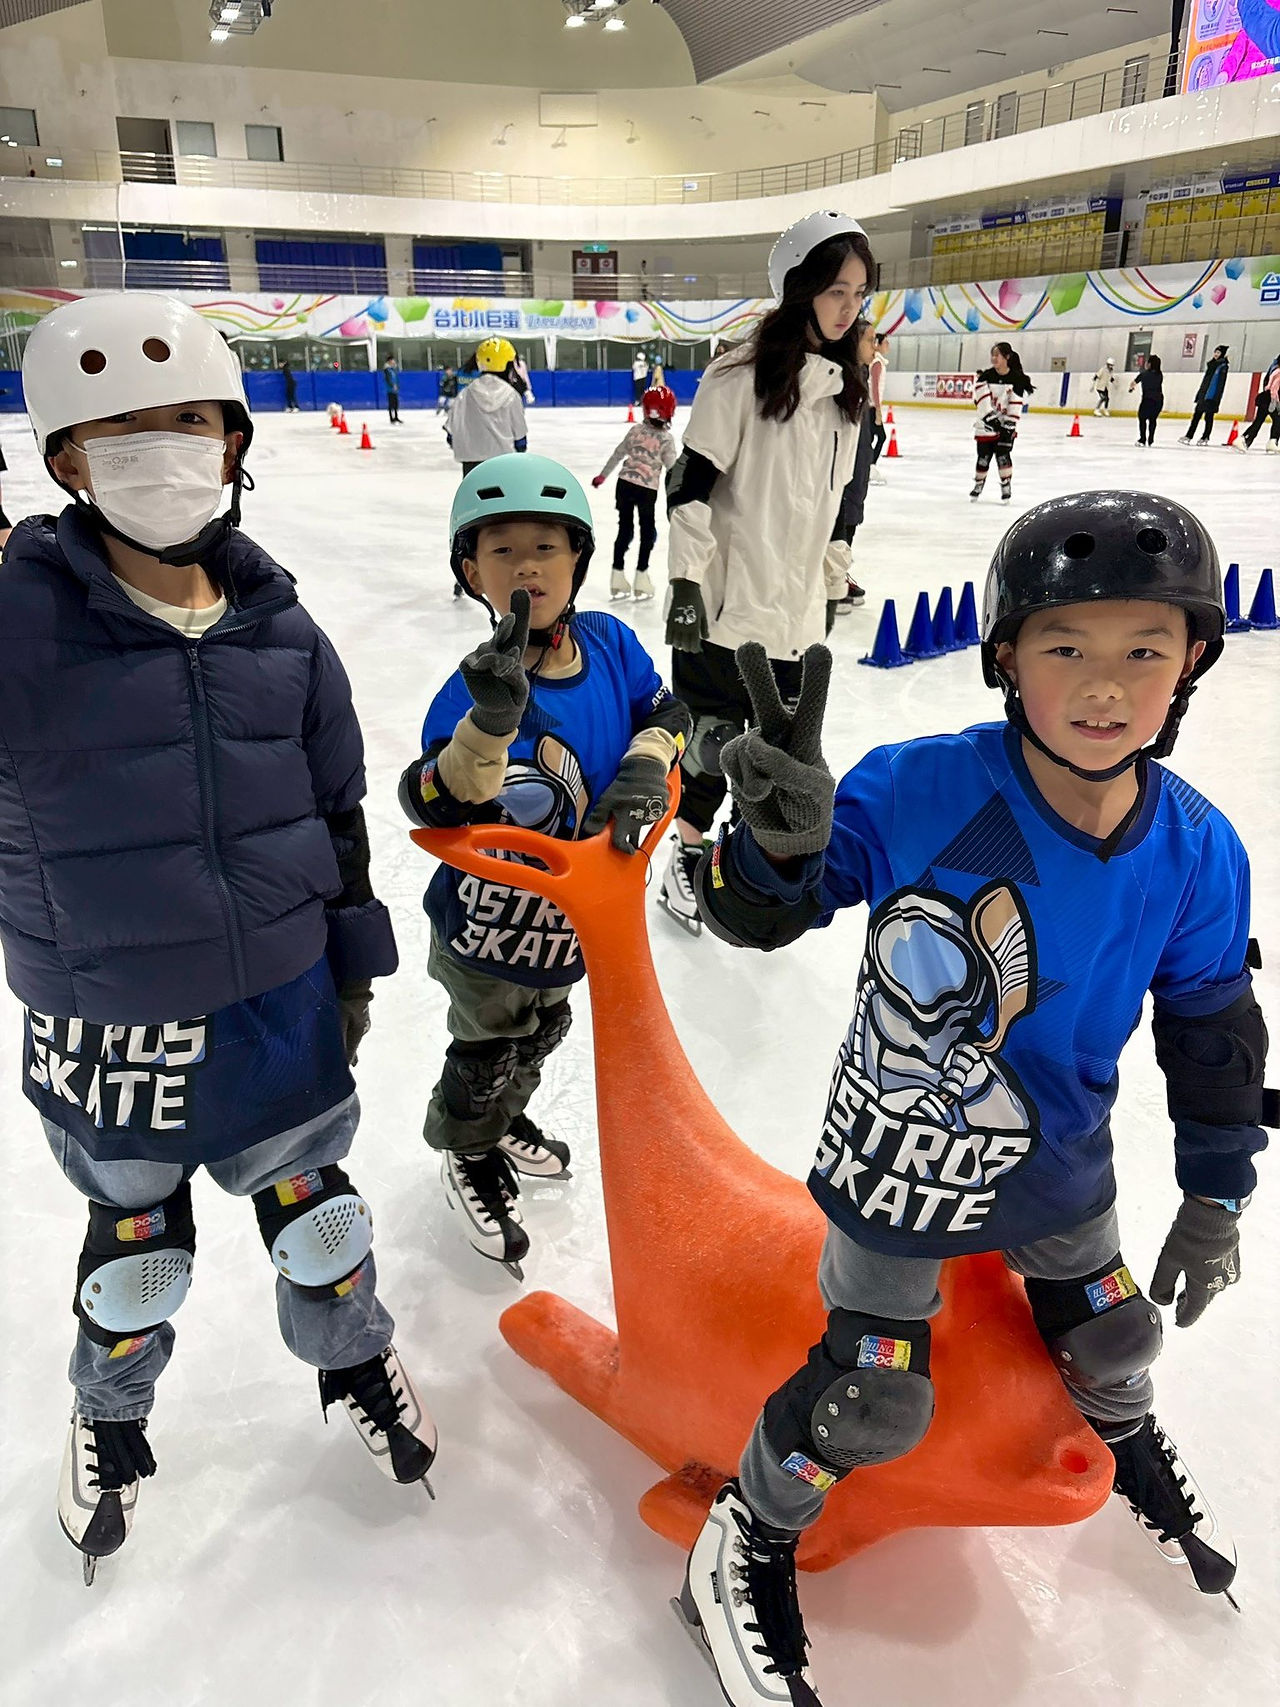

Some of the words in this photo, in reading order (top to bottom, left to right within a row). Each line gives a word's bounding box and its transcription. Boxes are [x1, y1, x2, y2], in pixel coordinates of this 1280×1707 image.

[435, 309, 521, 329] 台北小巨蛋
[457, 873, 574, 930] ASTR
[450, 919, 580, 969] SKATE
[29, 1045, 187, 1130] SKATE
[814, 1120, 997, 1232] SKATE
